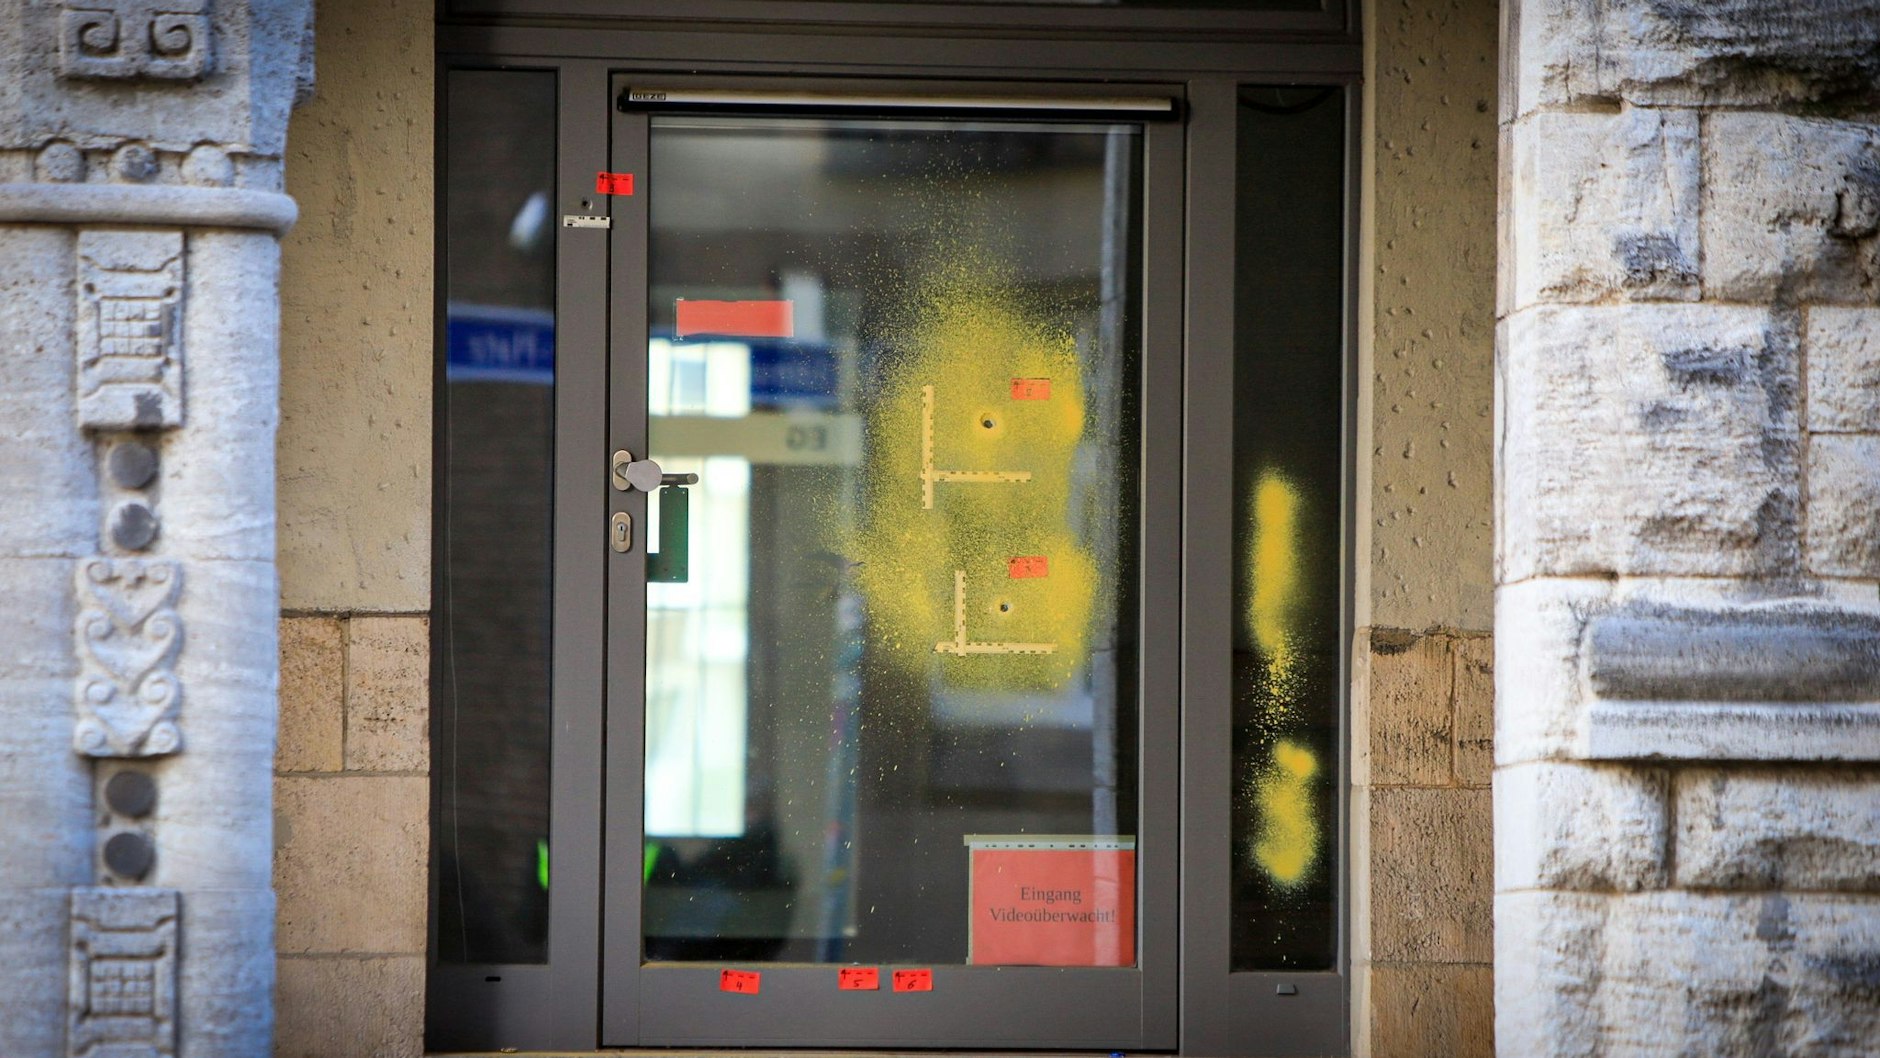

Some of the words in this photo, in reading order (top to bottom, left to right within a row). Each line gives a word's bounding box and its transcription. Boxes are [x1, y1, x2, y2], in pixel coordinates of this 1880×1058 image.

[1020, 886, 1082, 905] Eingang
[990, 908, 1116, 924] Videoüberwacht!
[735, 980, 743, 992] 4
[853, 978, 864, 988] 5
[907, 978, 915, 990] 6
